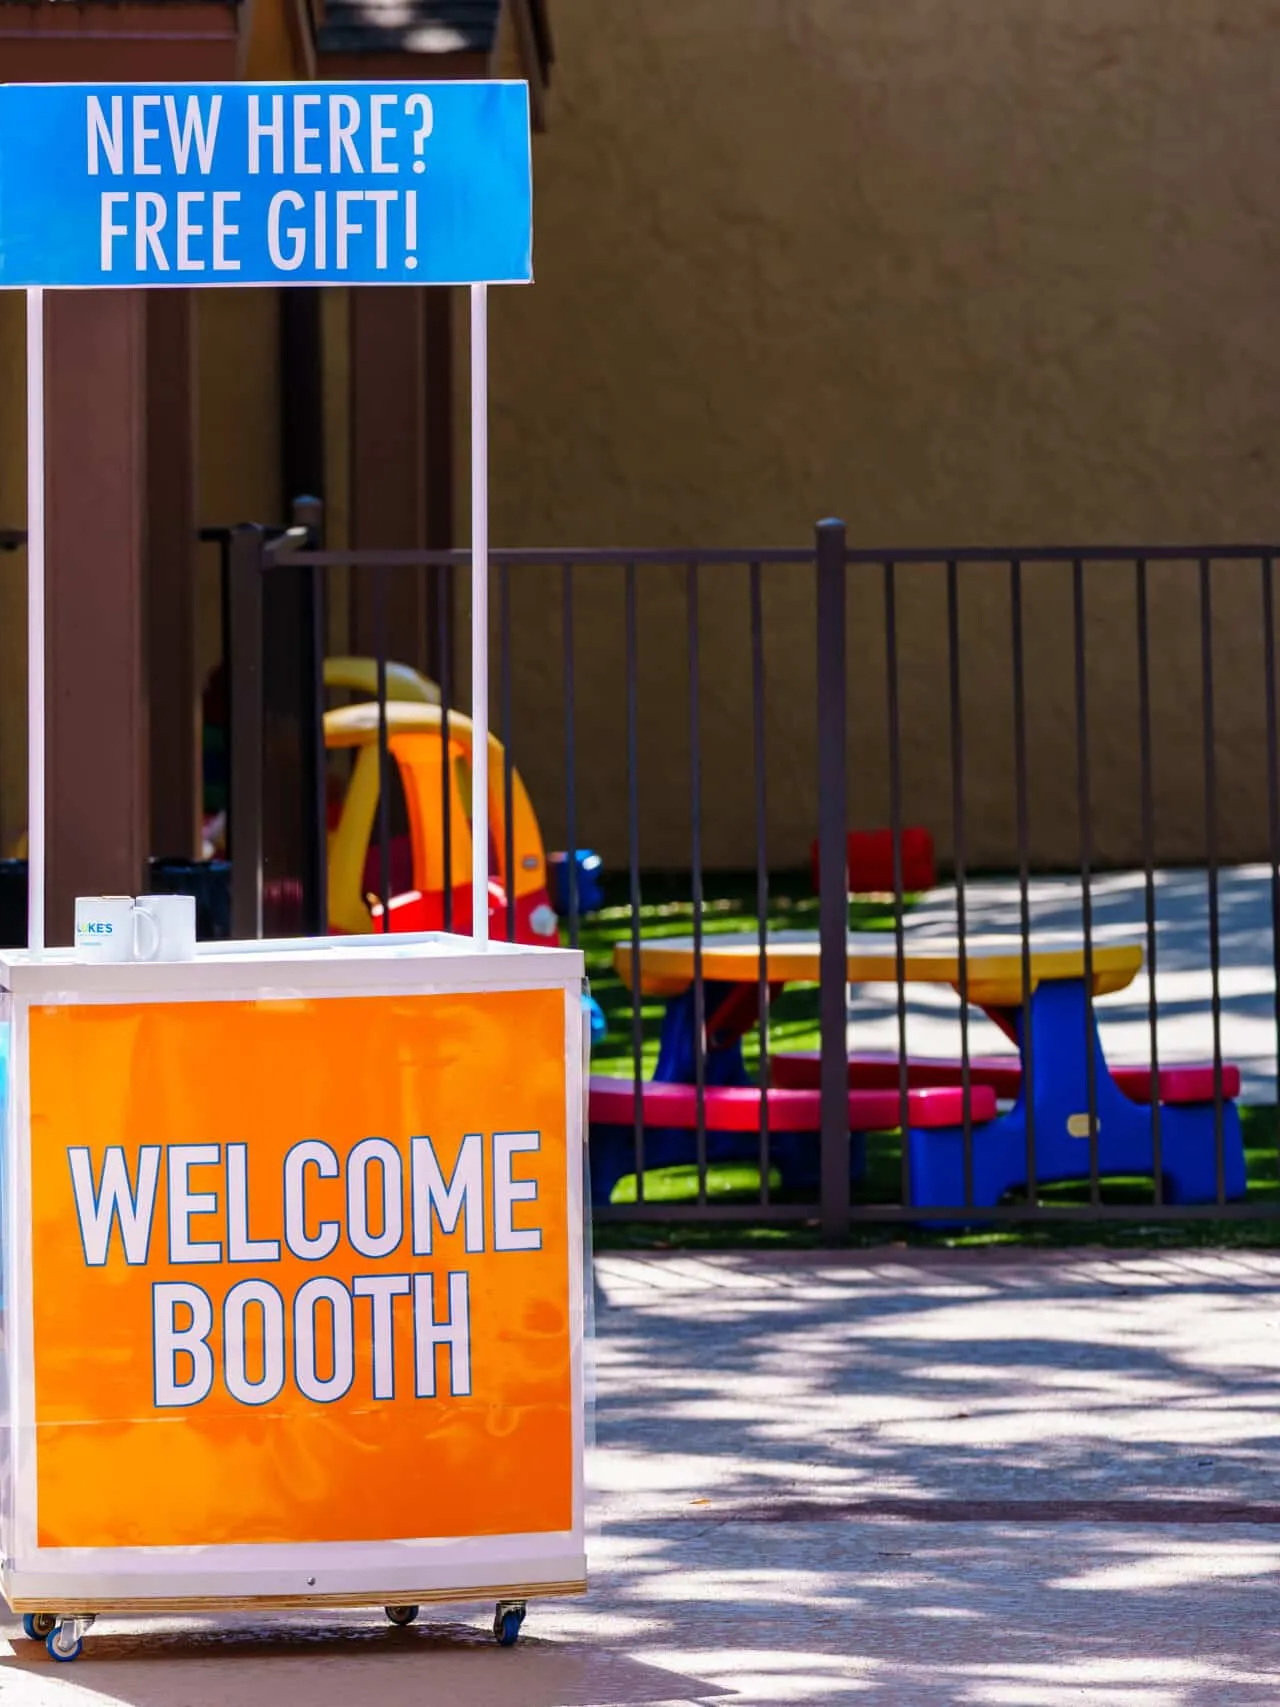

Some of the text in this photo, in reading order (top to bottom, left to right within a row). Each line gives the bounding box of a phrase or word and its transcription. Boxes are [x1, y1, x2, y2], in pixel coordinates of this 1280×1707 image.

[86, 92, 434, 176] NEW HERE?
[99, 189, 419, 272] FREE GIFT!
[66, 1130, 543, 1267] WELCOME
[151, 1271, 472, 1408] BOOTH
